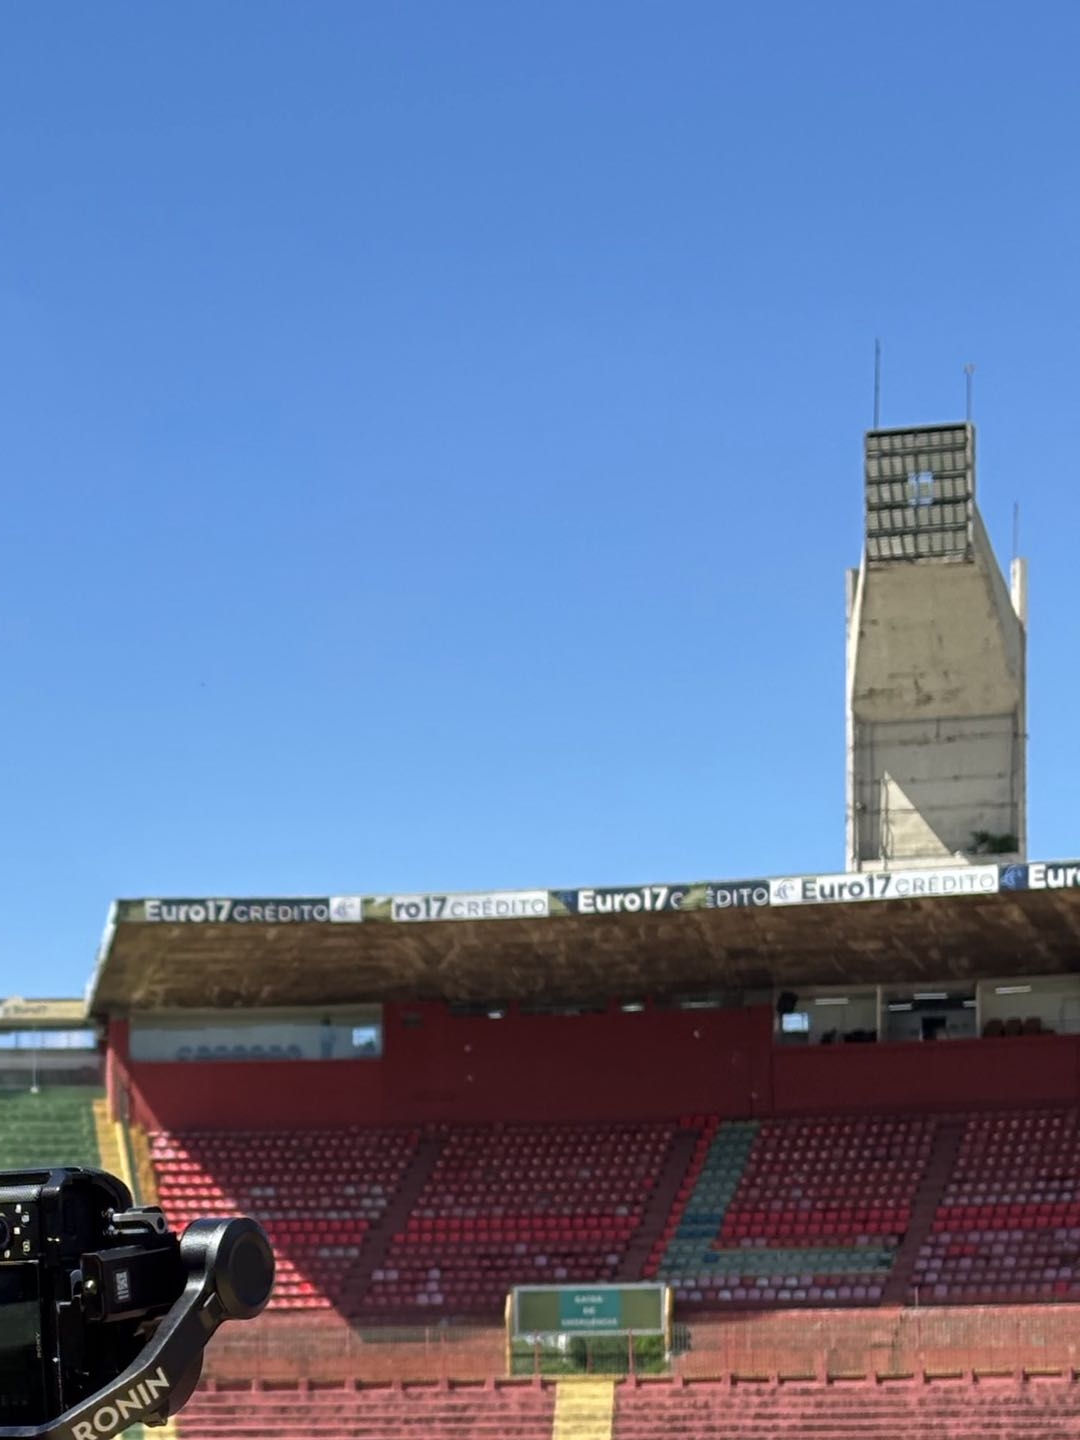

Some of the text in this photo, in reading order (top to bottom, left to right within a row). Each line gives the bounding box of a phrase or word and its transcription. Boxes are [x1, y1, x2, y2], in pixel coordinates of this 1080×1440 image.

[801, 872, 995, 900] Euro17 CRÉDITO
[1028, 863, 1080, 889] Eur
[144, 899, 329, 922] Euro17 CRÉDITO
[449, 898, 546, 917] CRÉDITO
[577, 885, 769, 914] Euro17 CÉDITO
